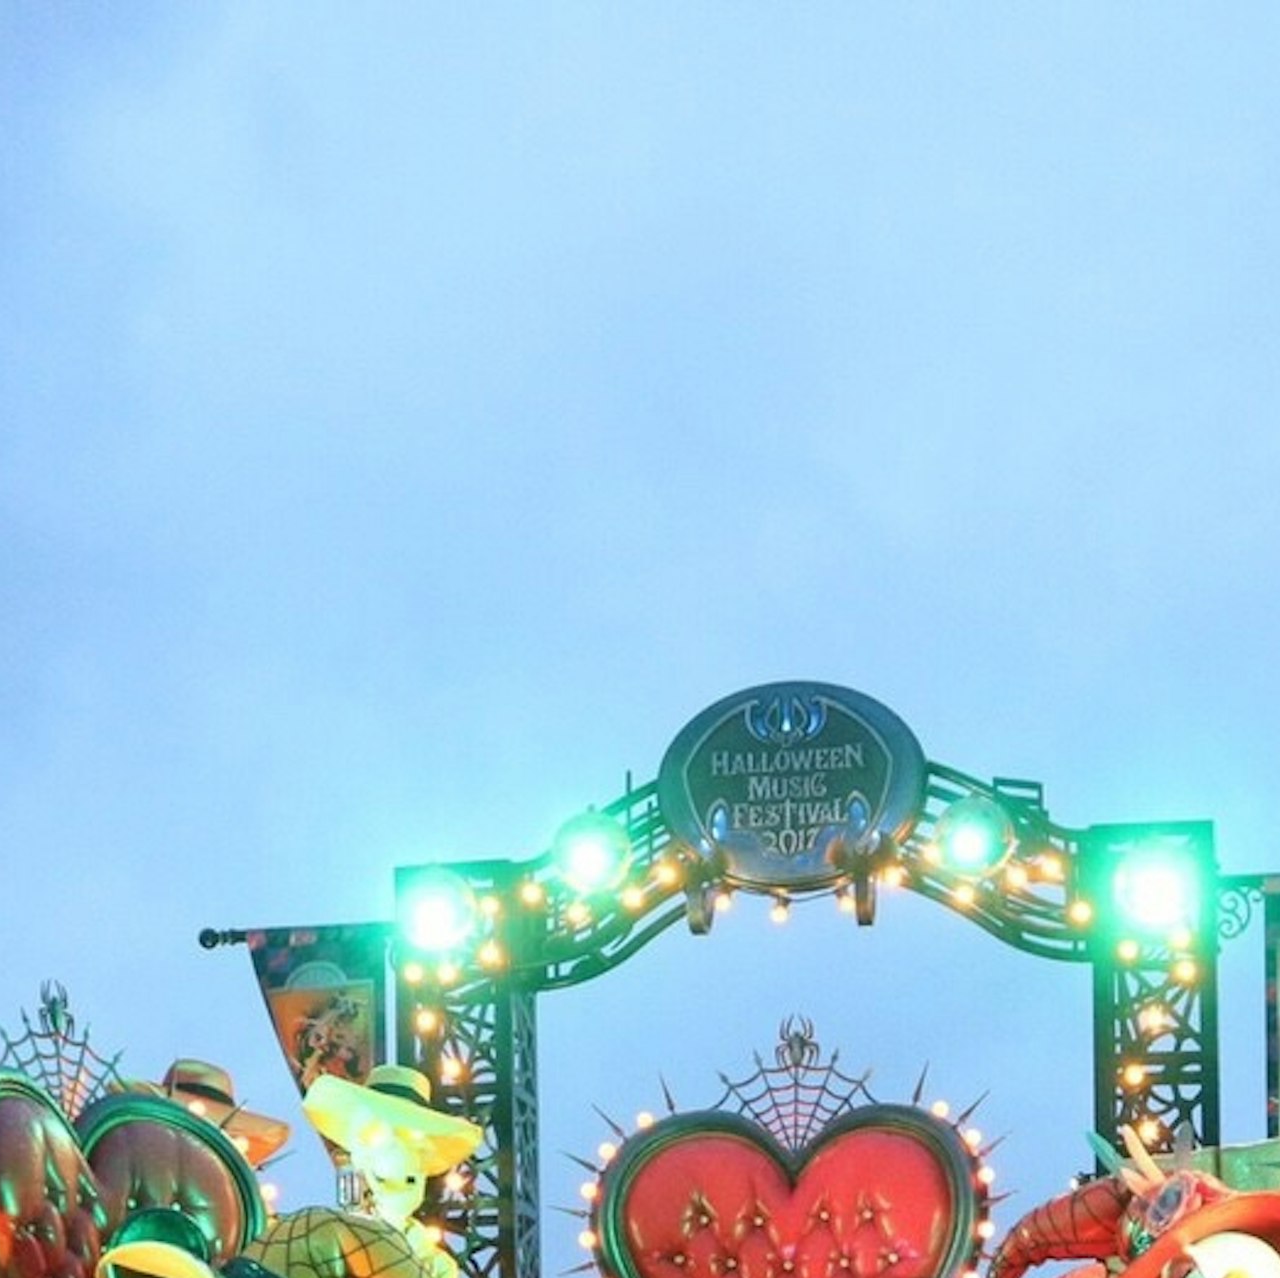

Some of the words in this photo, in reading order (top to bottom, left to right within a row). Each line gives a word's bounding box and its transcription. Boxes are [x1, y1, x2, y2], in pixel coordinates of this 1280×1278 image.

[712, 744, 864, 776] HALLOWEEN
[748, 774, 827, 801] MUSIC
[733, 798, 849, 830] FESTIVAL
[764, 829, 820, 856] 2017
